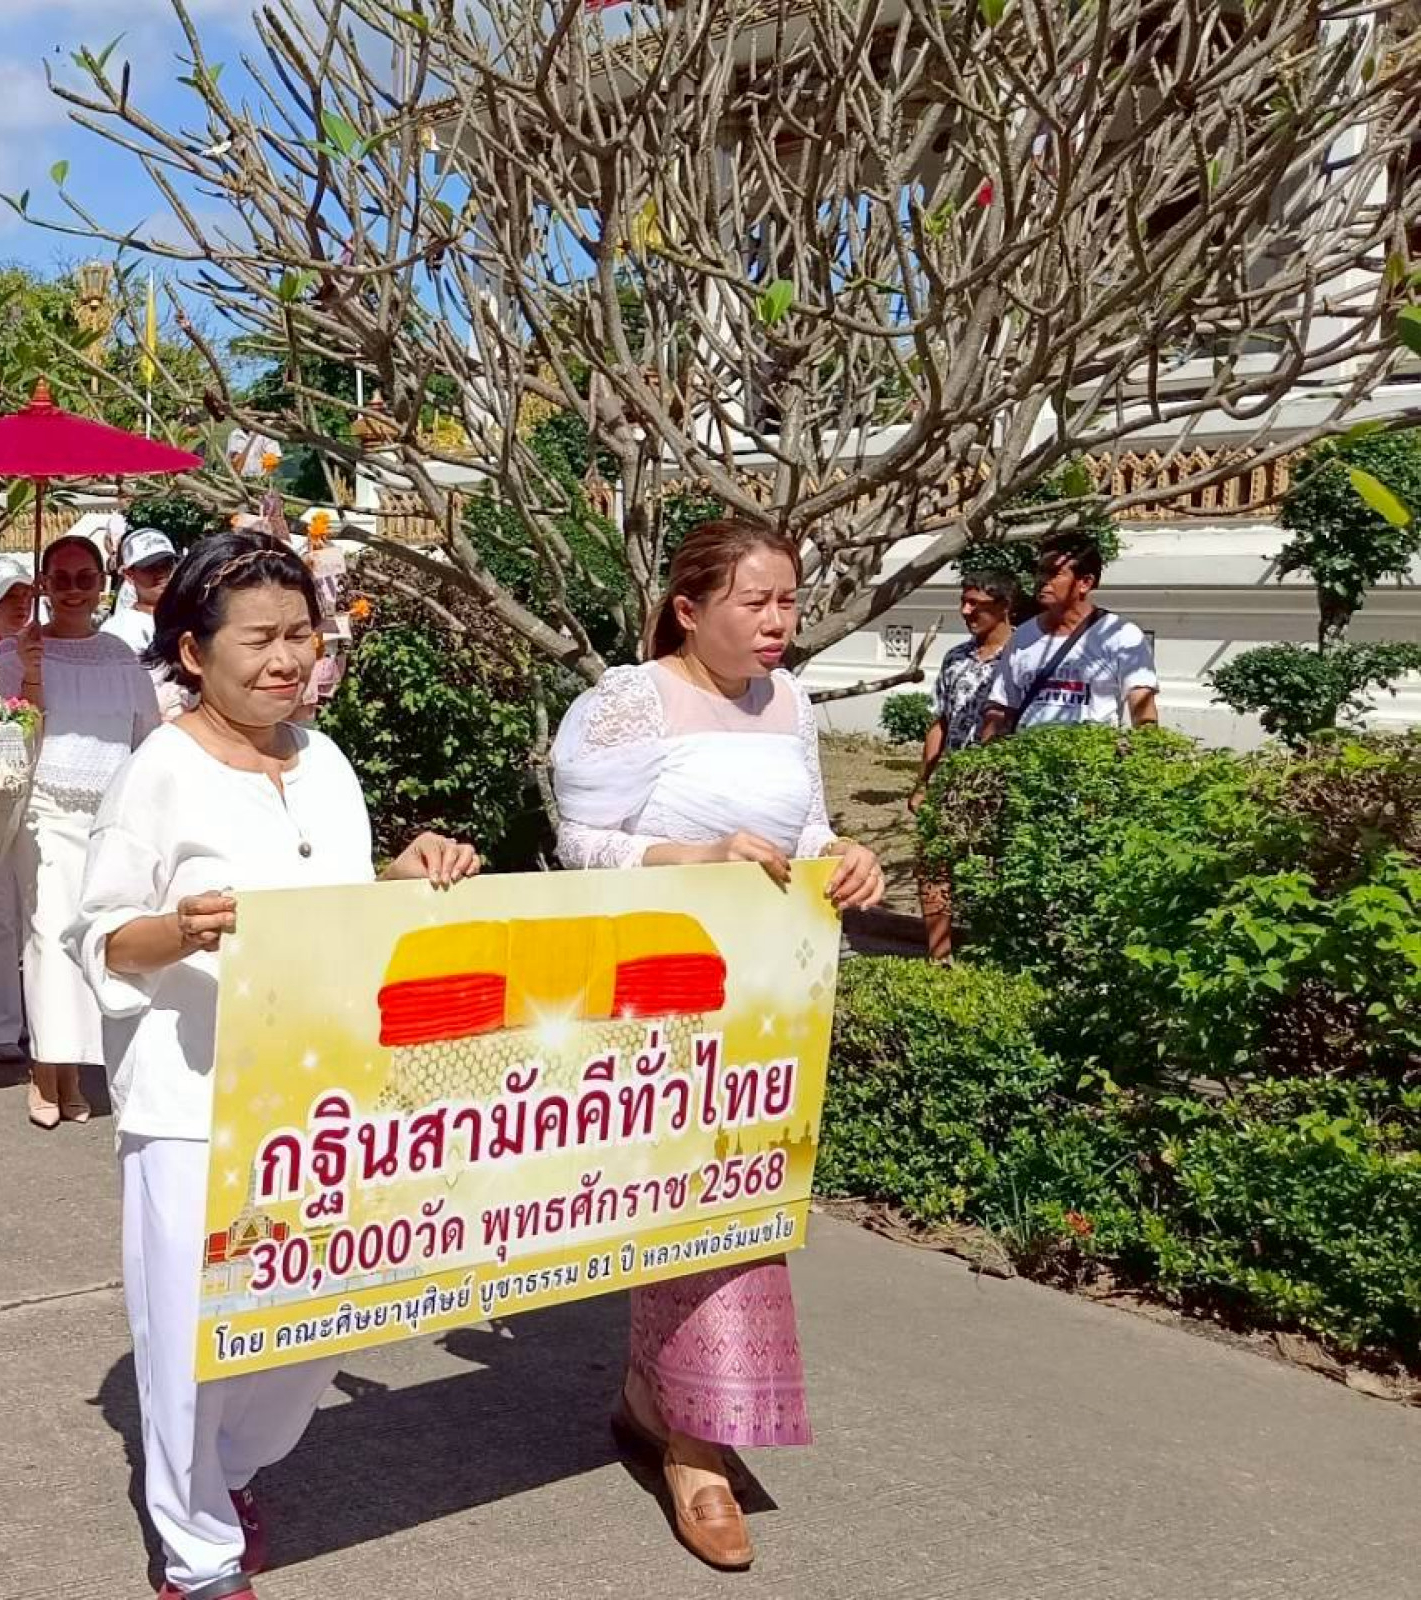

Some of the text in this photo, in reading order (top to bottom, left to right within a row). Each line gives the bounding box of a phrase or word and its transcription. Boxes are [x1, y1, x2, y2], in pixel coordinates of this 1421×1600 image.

[261, 1030, 794, 1219] กฐินสามัคคีทั่วไทย
[250, 1152, 786, 1291] 30,000วัด พุทธศักราช 2568
[214, 1325, 265, 1360] โดย
[276, 1275, 472, 1348] คณะศิษยานุศิษย์
[480, 1265, 579, 1313] บูชาธรรม
[586, 1254, 612, 1280] 81
[621, 1243, 636, 1272] ปี
